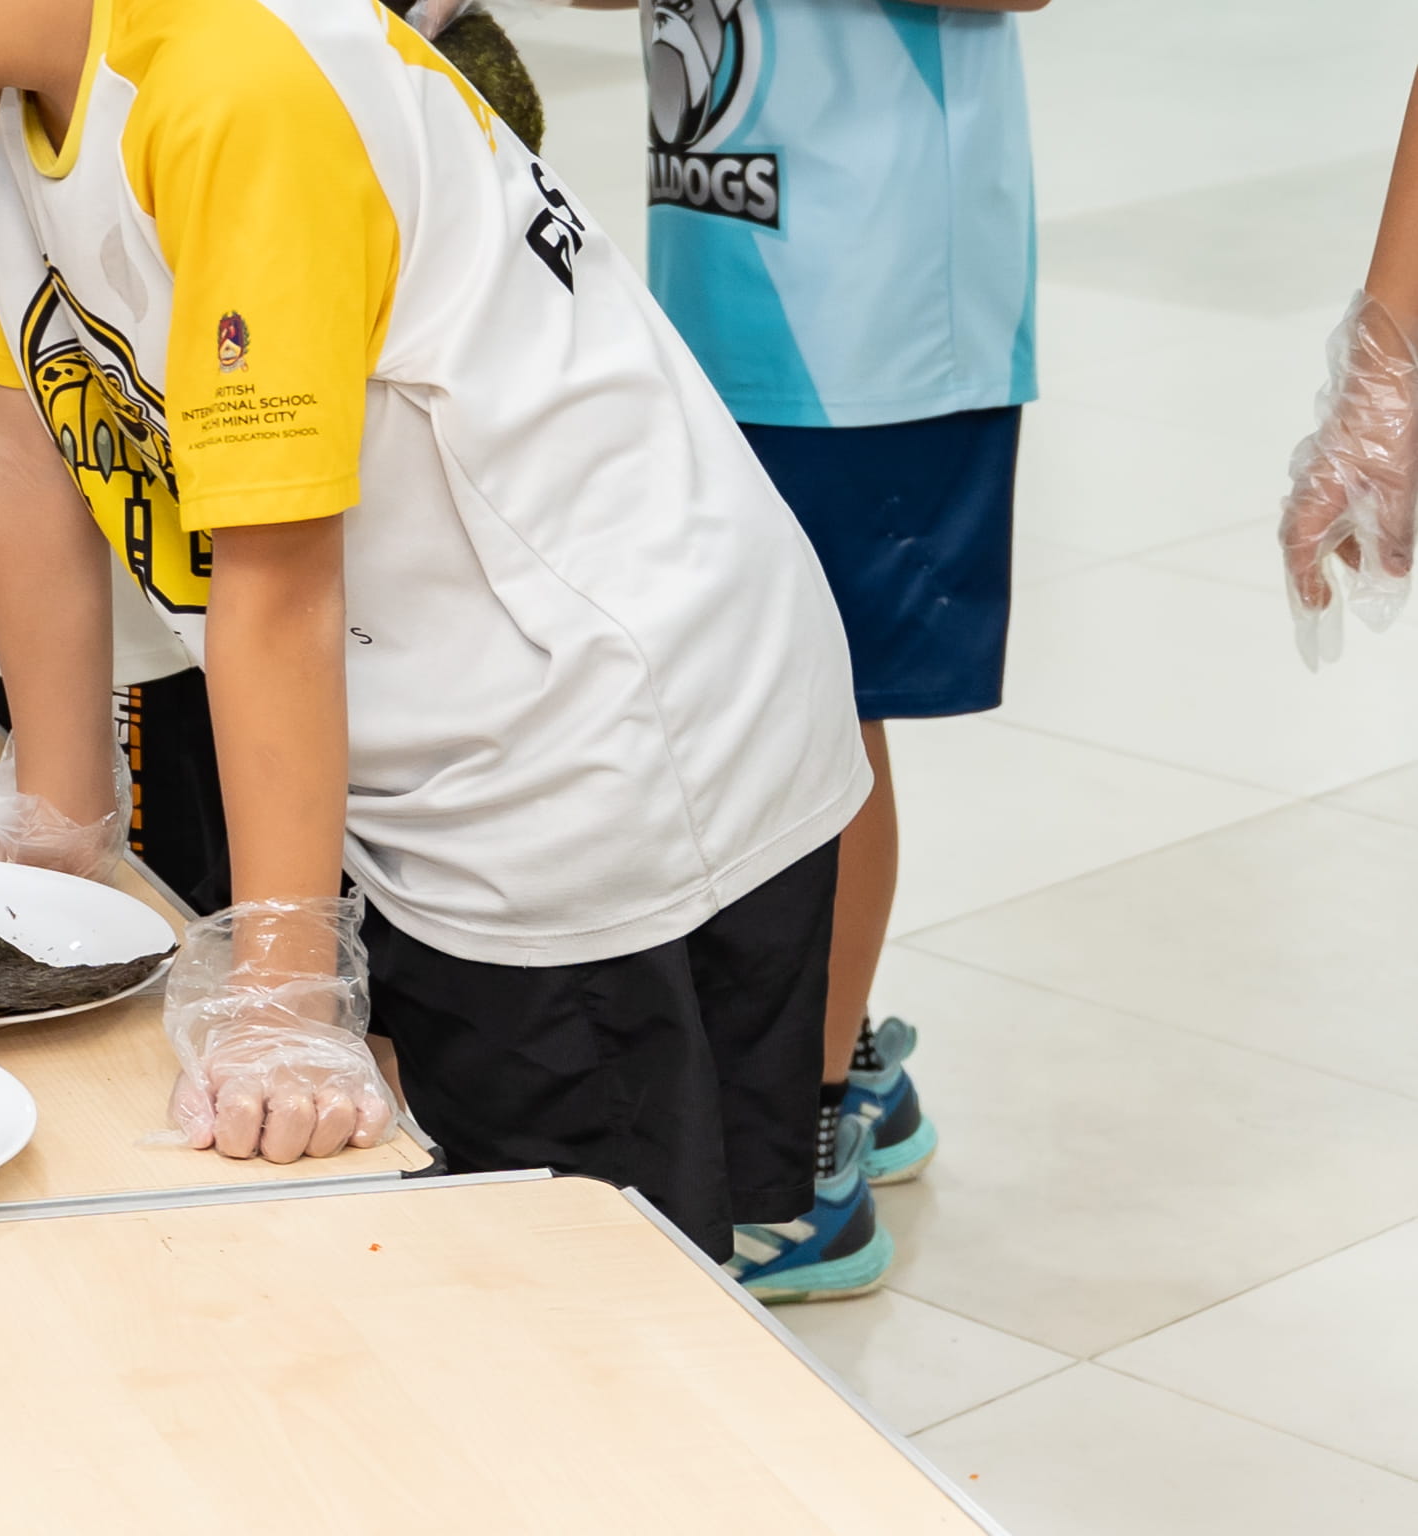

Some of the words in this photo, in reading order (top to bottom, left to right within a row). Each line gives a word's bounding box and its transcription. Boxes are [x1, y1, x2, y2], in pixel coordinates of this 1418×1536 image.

[648, 153, 778, 220] LLDOGS
[259, 393, 318, 409] SCHOOL
[222, 413, 260, 427] MINH
[263, 410, 297, 424] CITY
[224, 430, 281, 444] EDUCATION
[282, 427, 319, 439] SCHOOL
